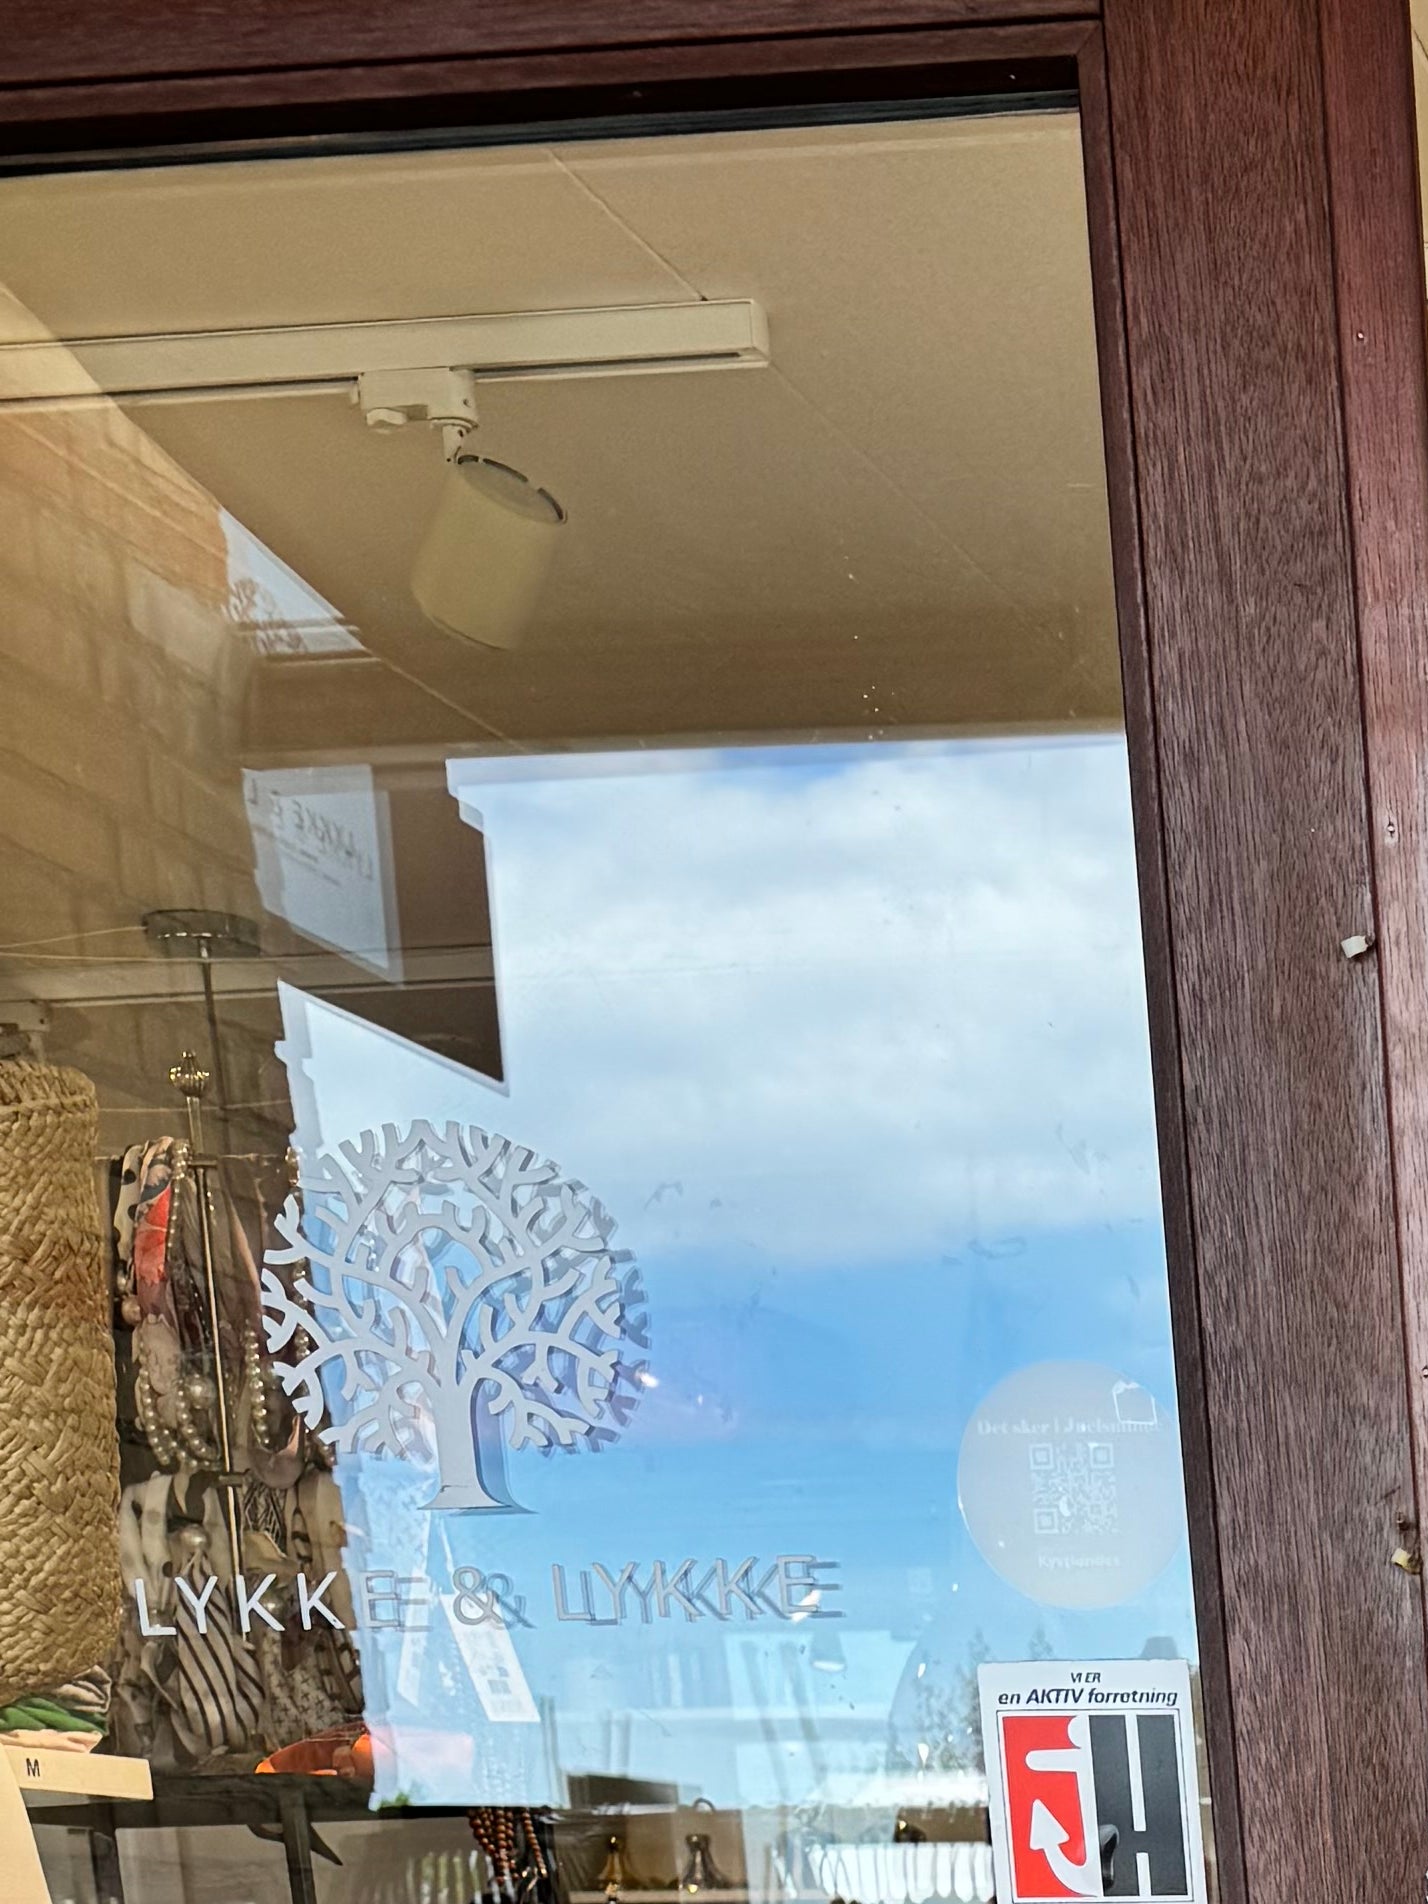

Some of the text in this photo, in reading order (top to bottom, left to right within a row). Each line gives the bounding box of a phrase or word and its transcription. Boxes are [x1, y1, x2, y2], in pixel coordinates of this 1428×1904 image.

[134, 1554, 818, 1637] LYKKE & LYKKE
[1070, 1672, 1101, 1684] VI ER
[997, 1687, 1179, 1707] en AKTIV forretning
[26, 1757, 41, 1777] M
